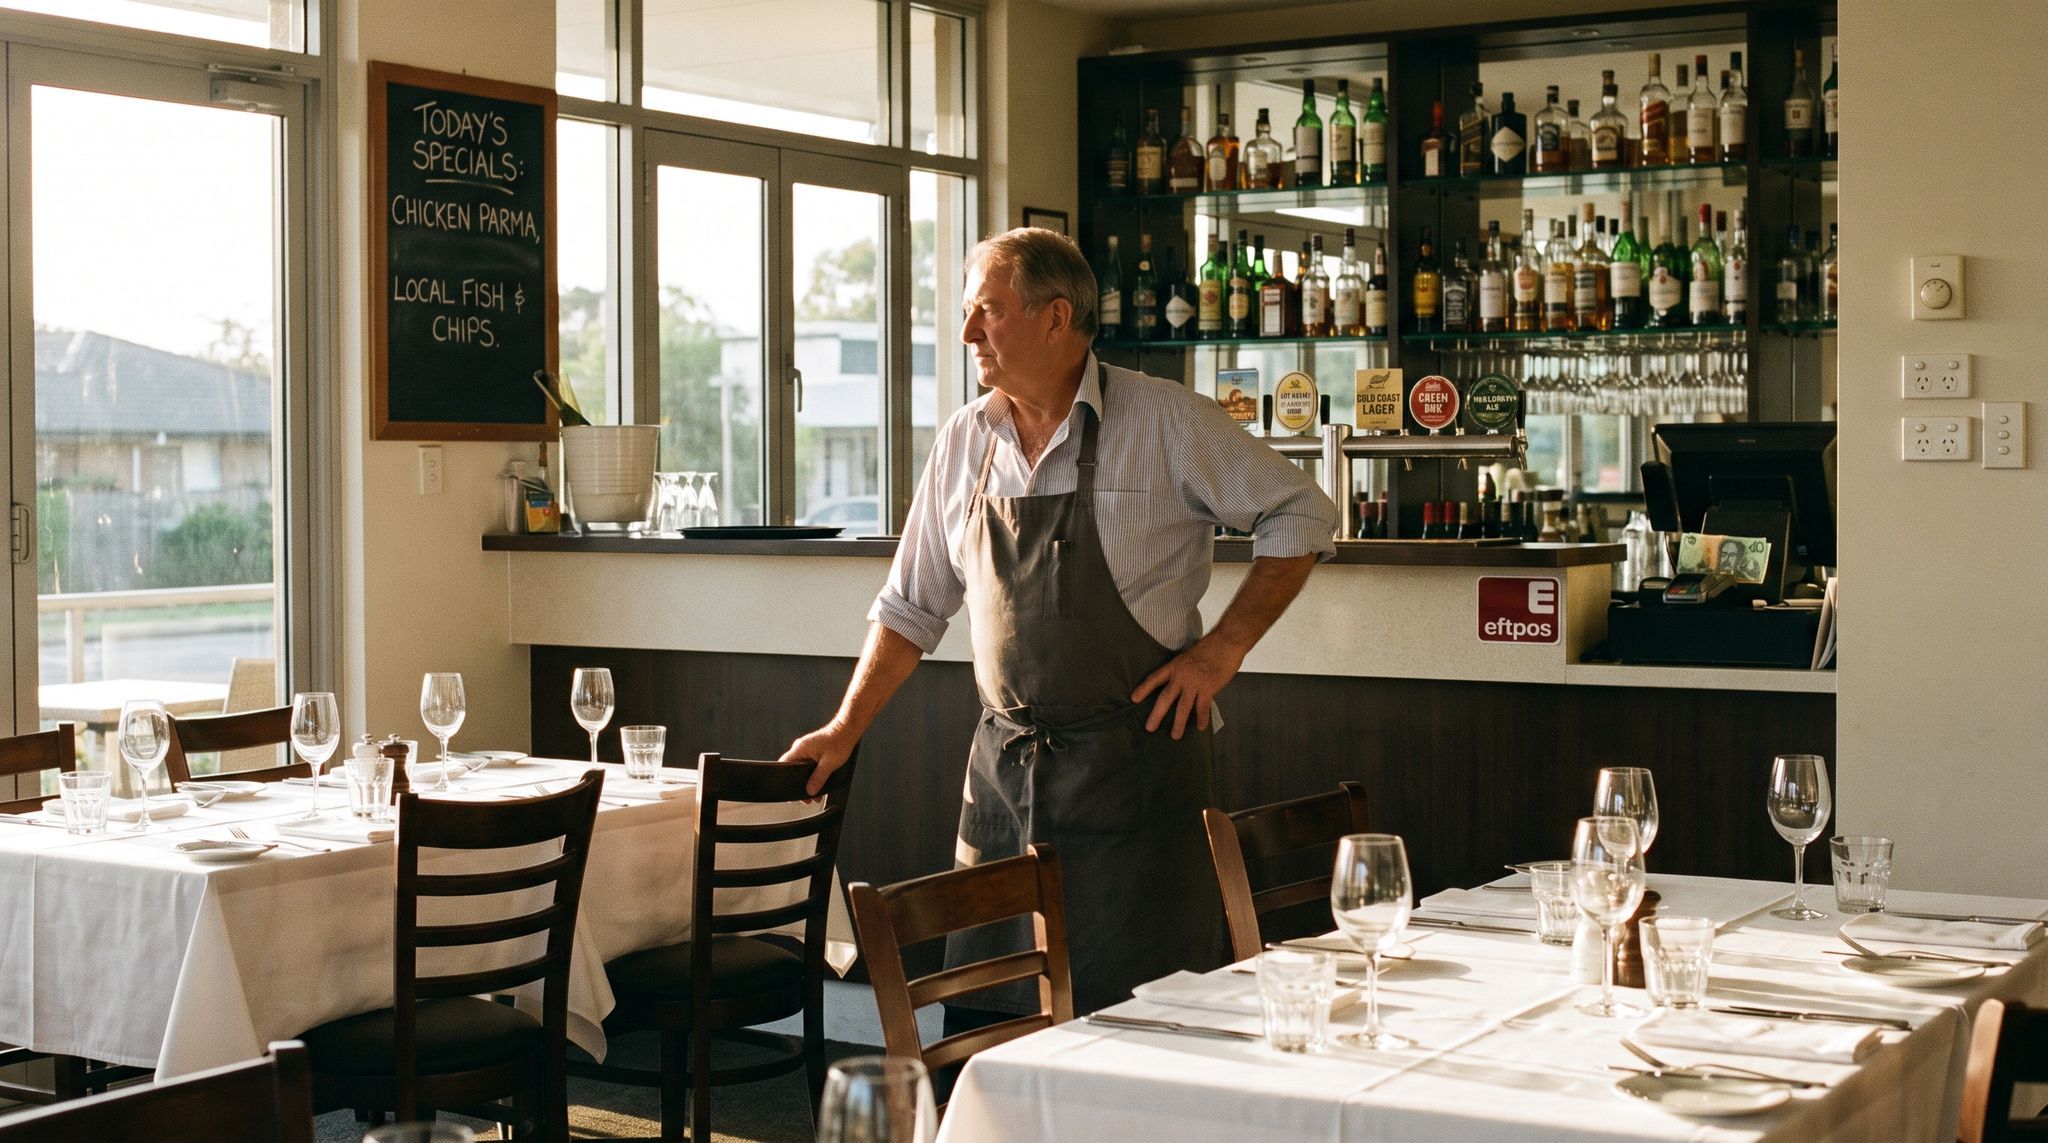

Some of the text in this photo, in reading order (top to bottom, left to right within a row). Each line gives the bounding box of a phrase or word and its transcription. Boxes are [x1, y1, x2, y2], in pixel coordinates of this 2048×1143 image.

[413, 101, 508, 146] TODAY'S
[412, 140, 525, 182] SPECIALS:
[392, 194, 541, 244] CHICKEN PARMA,
[393, 275, 456, 305] LOCAL
[462, 278, 504, 312] FISH
[432, 315, 500, 348] CHIPS.
[1362, 404, 1395, 415] LAGER
[1377, 393, 1400, 403] COAST
[1484, 617, 1552, 641] eftpos
